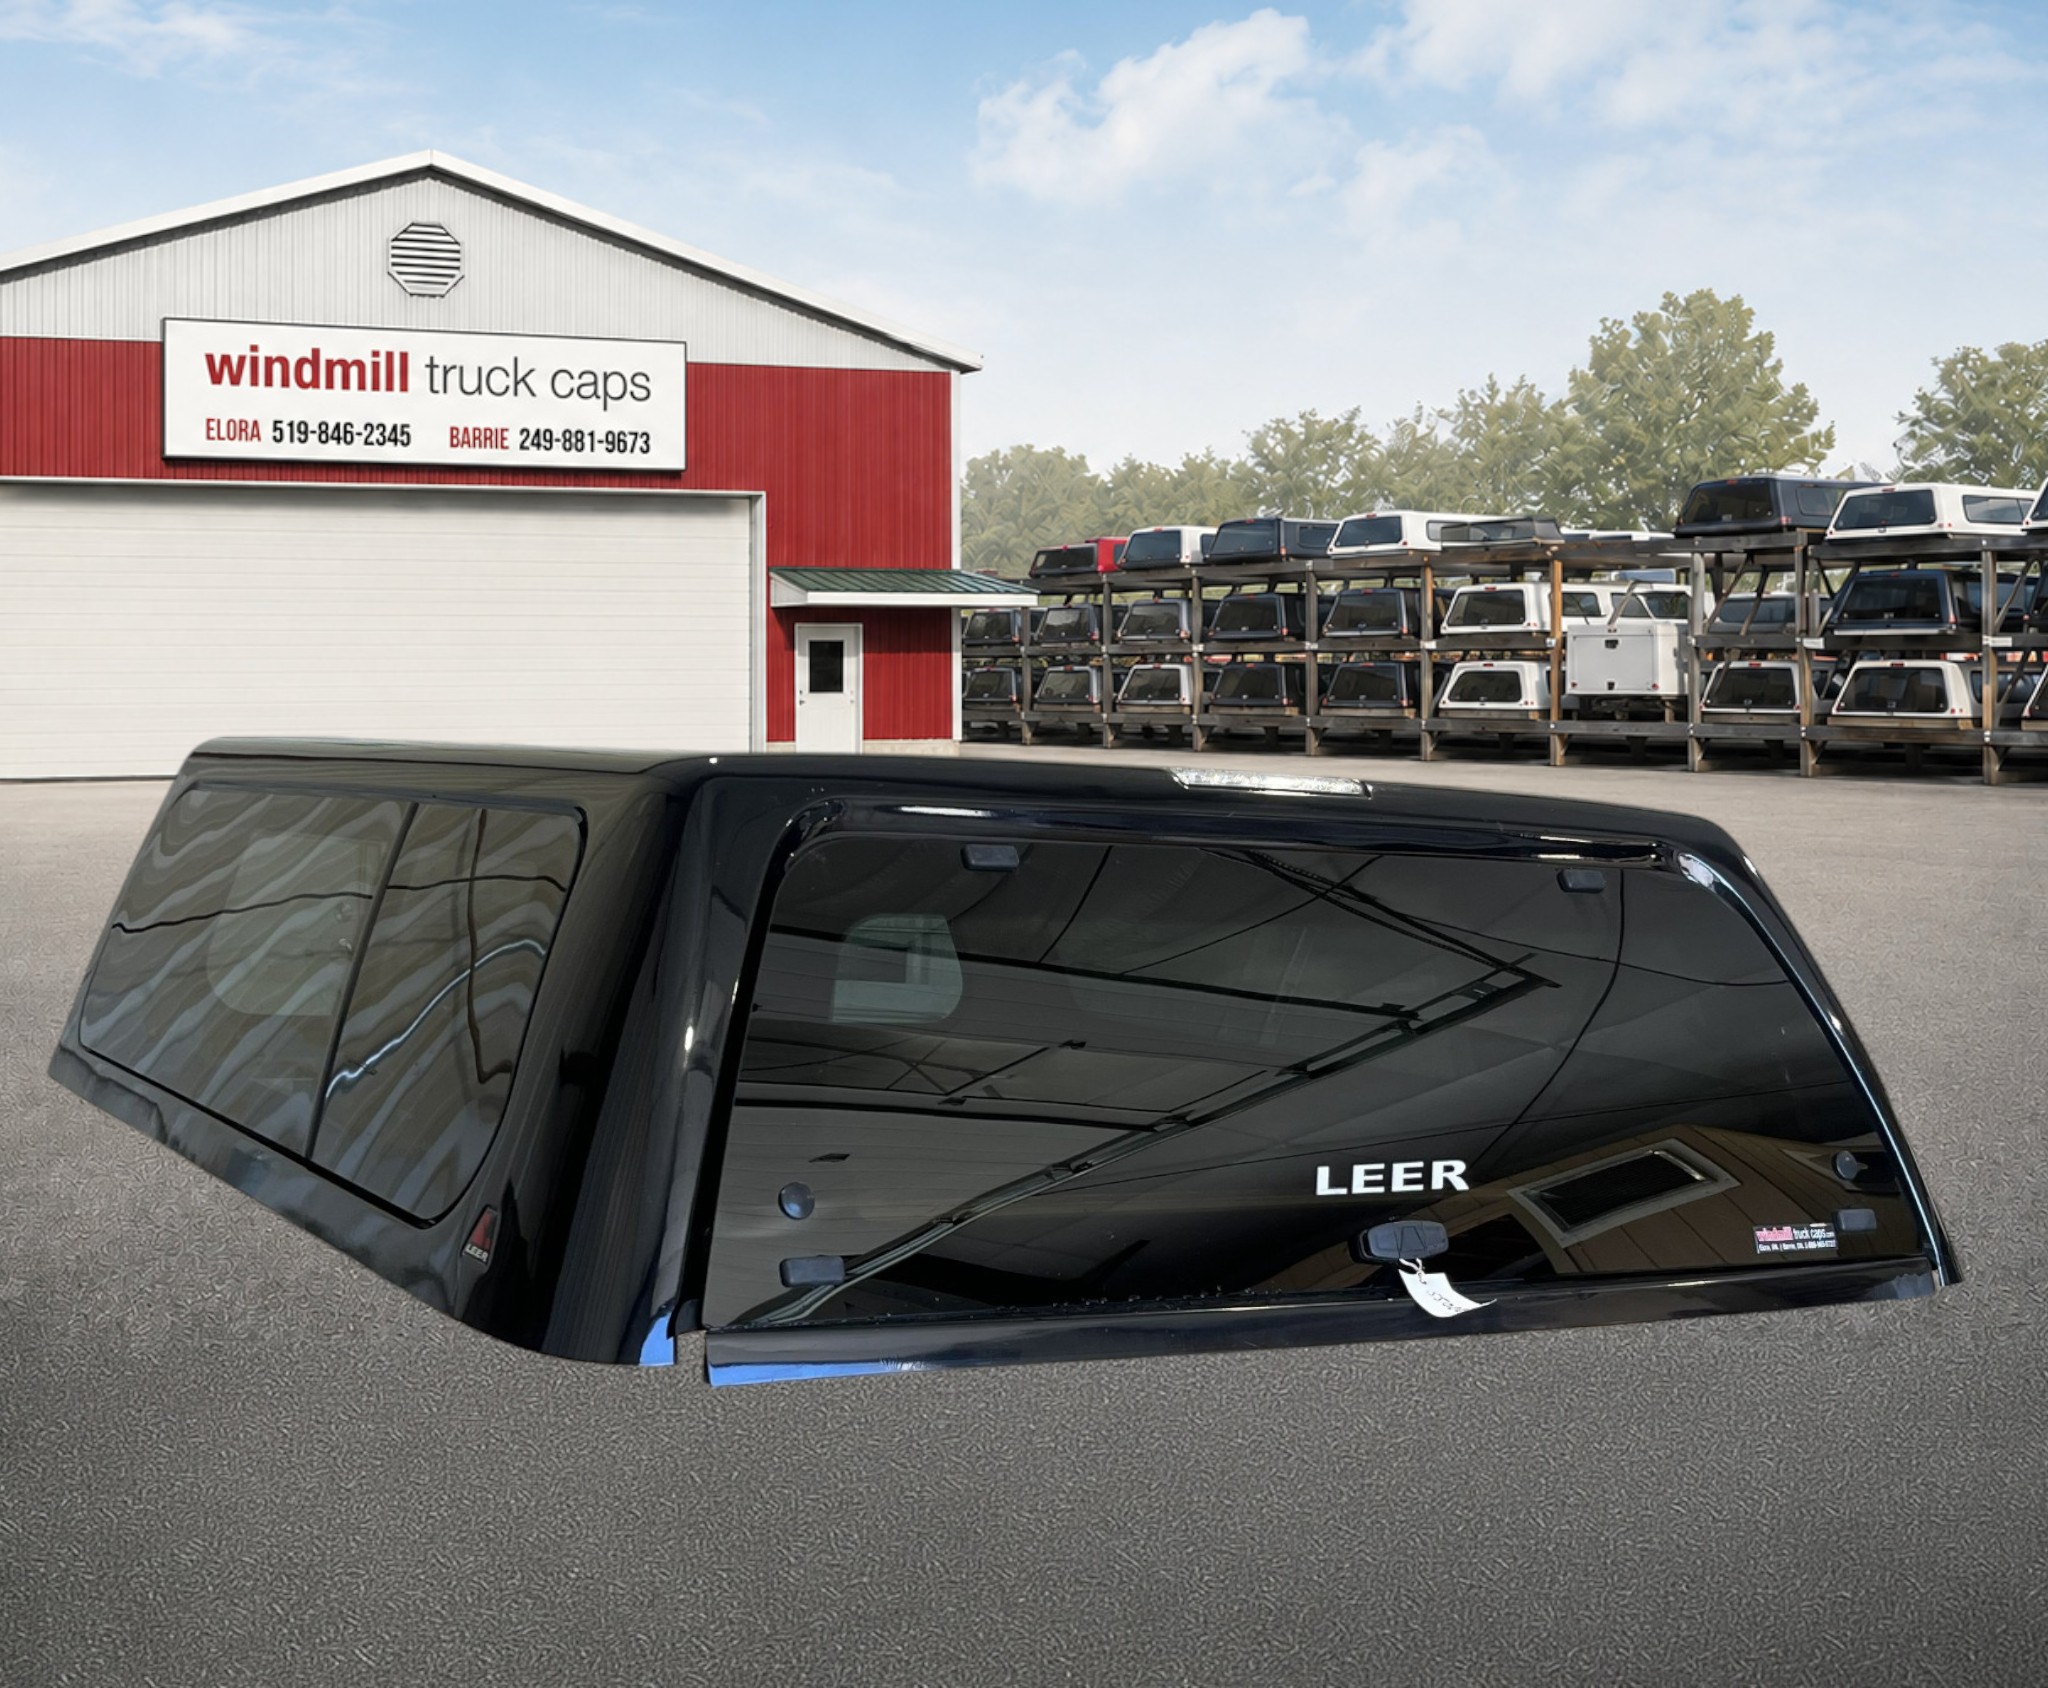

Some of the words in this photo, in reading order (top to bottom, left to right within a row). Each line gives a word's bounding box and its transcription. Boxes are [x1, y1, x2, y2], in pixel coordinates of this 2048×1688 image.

[204, 344, 409, 393] windmill
[424, 355, 537, 398] truck
[550, 369, 652, 412] caps
[206, 418, 262, 443] ELORA
[272, 419, 412, 448] 519-846-2345
[449, 426, 510, 450] BARRIE
[518, 427, 651, 455] 249-881-9673
[1316, 1159, 1469, 1196] LEER
[466, 1244, 489, 1262] LEER
